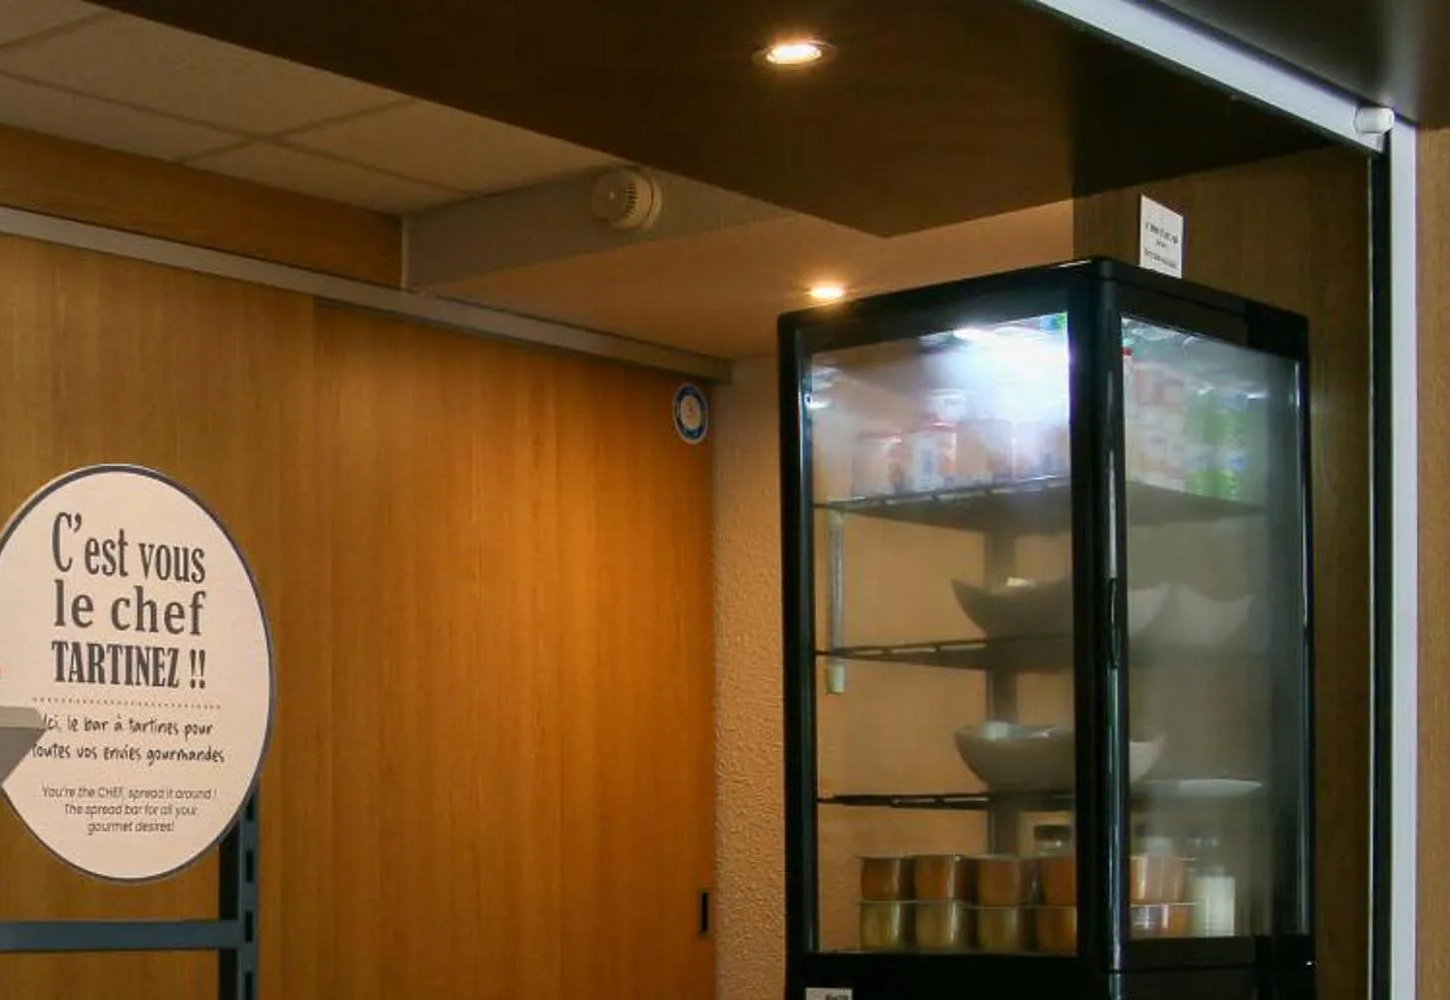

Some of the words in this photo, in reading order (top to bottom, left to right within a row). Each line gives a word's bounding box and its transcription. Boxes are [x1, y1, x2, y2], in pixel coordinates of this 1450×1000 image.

[138, 542, 206, 584] vous
[53, 579, 94, 629] le
[110, 585, 206, 635] chef
[51, 640, 180, 688] TARTINEZ
[67, 715, 78, 732] le
[84, 716, 109, 733] bar
[129, 717, 179, 736] tartines
[184, 721, 214, 742] pour
[77, 746, 97, 761] vos
[103, 744, 142, 762] envies
[146, 746, 225, 767] gourmandes
[77, 786, 95, 798] the
[128, 787, 164, 802] spread
[175, 787, 212, 800] around
[65, 803, 83, 816] The
[85, 804, 122, 819] spread
[124, 804, 142, 816] bar
[144, 804, 158, 816] for
[175, 806, 198, 819] your
[87, 820, 133, 836] gourmet
